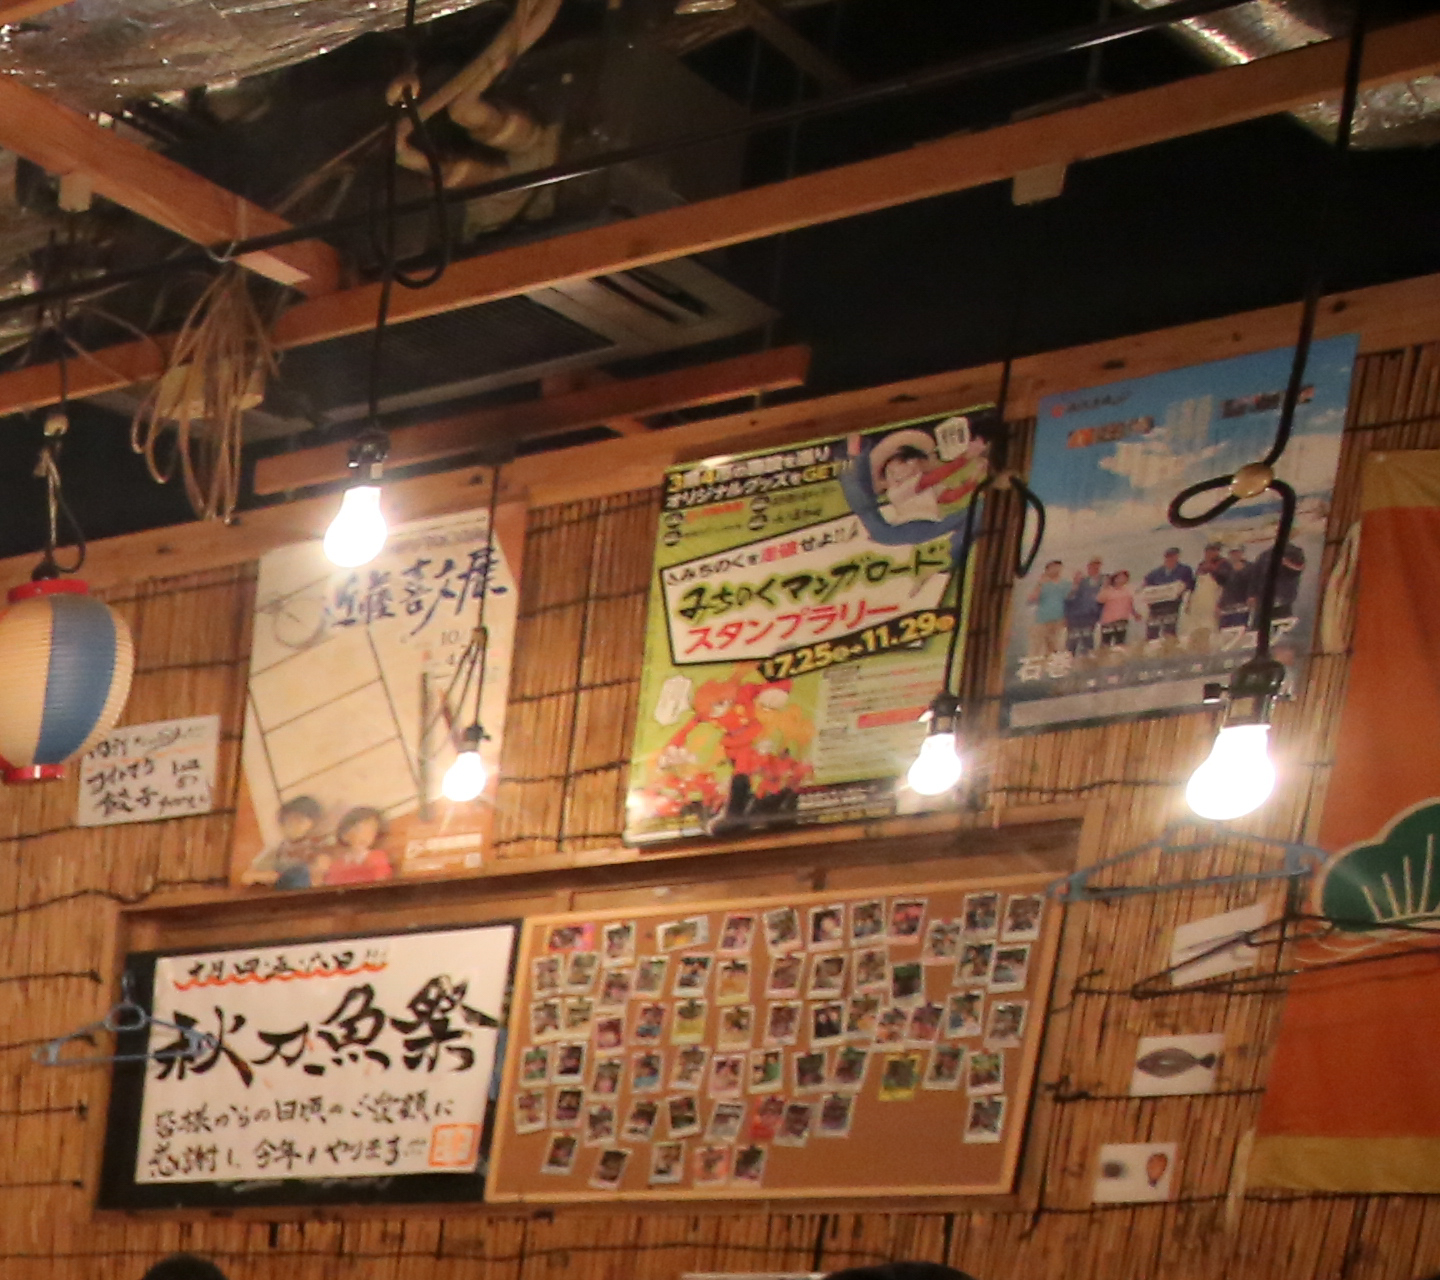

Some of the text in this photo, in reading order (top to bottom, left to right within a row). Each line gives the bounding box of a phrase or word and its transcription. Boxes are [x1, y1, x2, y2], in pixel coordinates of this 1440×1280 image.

[685, 600, 898, 654] スタンプラリー
[154, 974, 499, 1088] 秋刀魚祭
